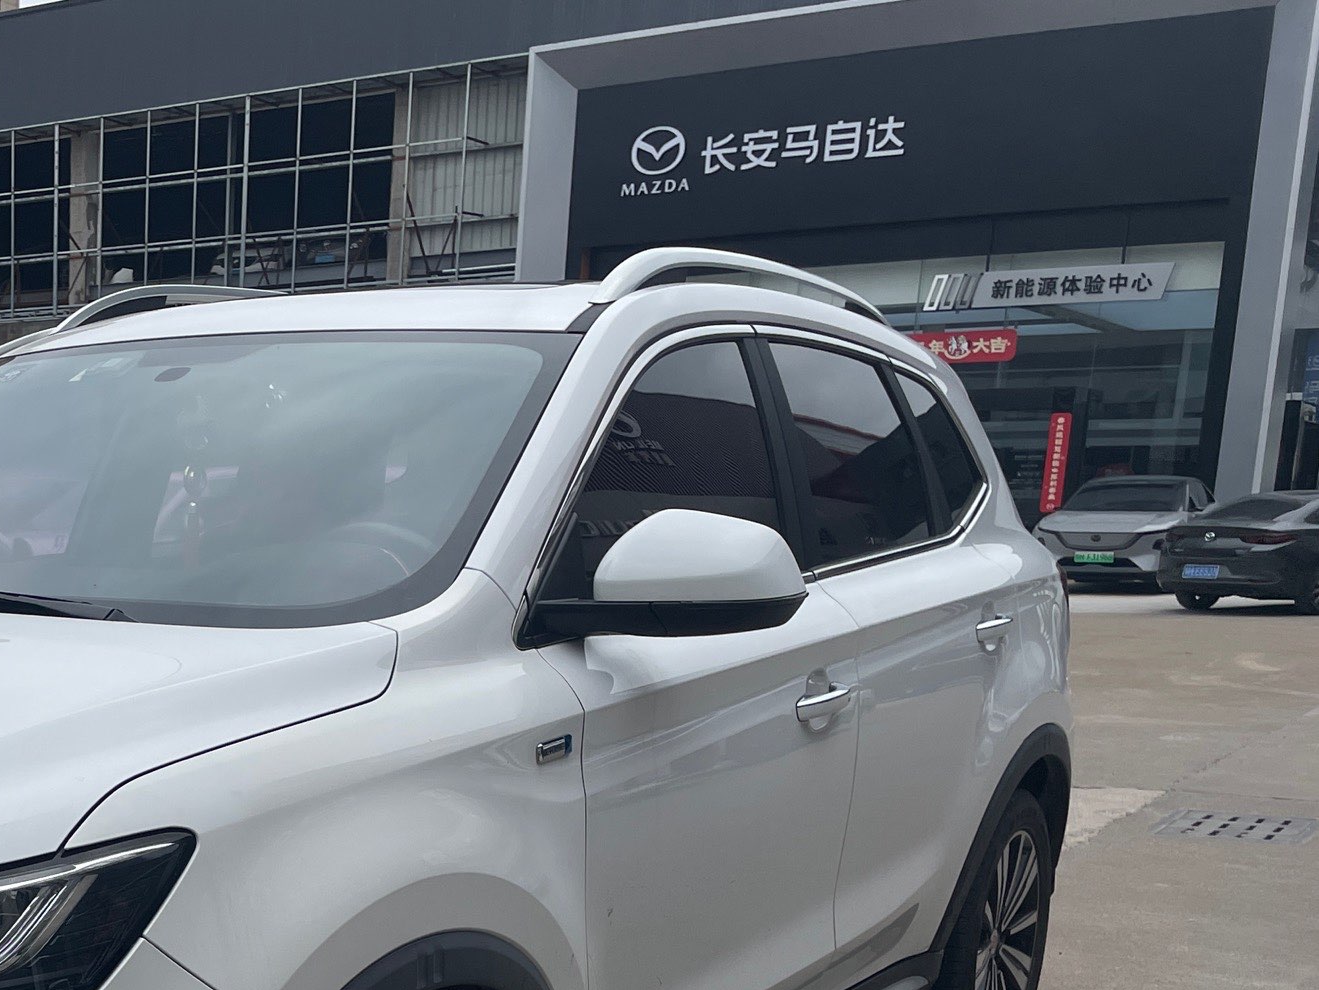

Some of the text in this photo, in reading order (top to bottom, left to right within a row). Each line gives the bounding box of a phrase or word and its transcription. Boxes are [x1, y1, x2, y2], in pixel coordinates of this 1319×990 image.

[700, 115, 906, 175] 长安马自达
[620, 177, 690, 197] MAZDA
[990, 272, 1154, 300] 新能源体验中心
